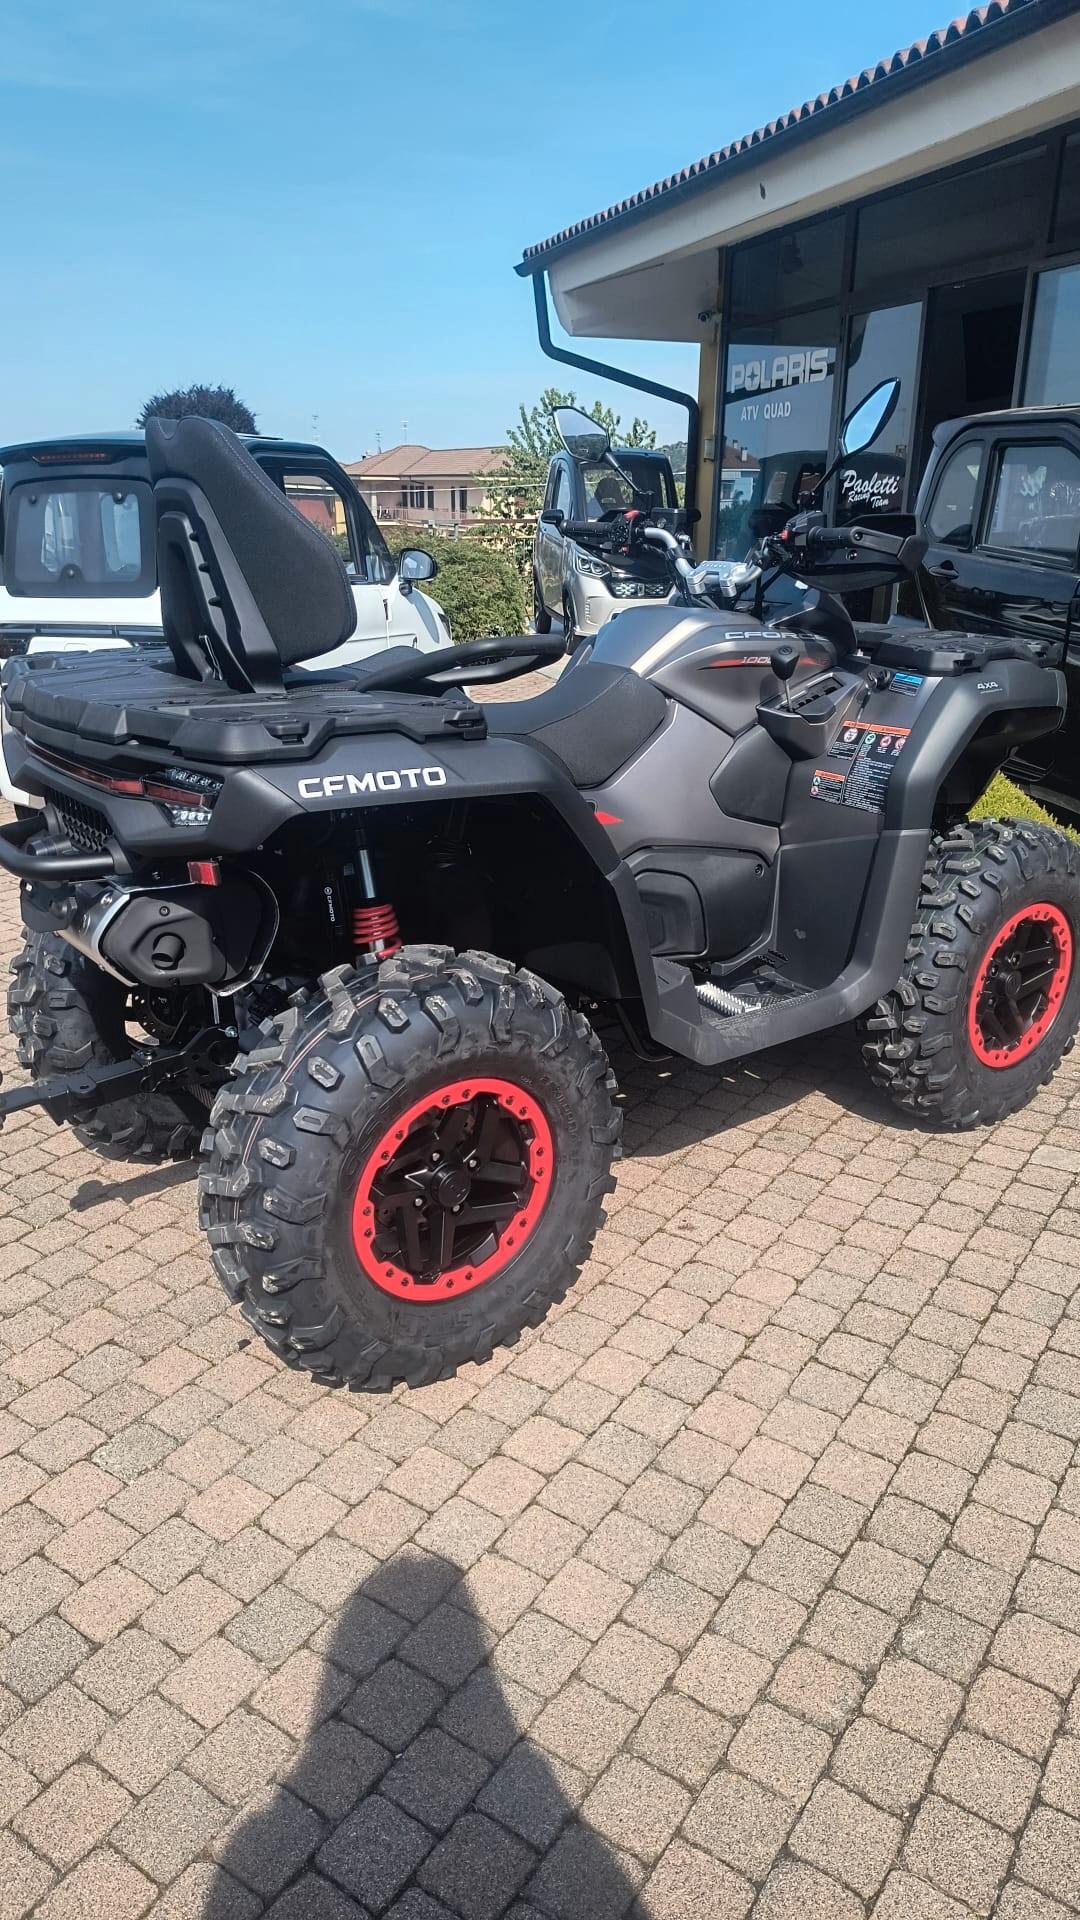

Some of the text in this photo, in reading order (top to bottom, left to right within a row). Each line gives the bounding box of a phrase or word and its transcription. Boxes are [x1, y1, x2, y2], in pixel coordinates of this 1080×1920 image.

[730, 348, 829, 393] POLARIS
[740, 401, 791, 421] ATV QUAD
[841, 469, 900, 495] Paoletti
[847, 490, 871, 504] Racing
[870, 495, 889, 508] Team
[298, 766, 447, 799] CFMOTO
[326, 895, 336, 922] CFMOTO
